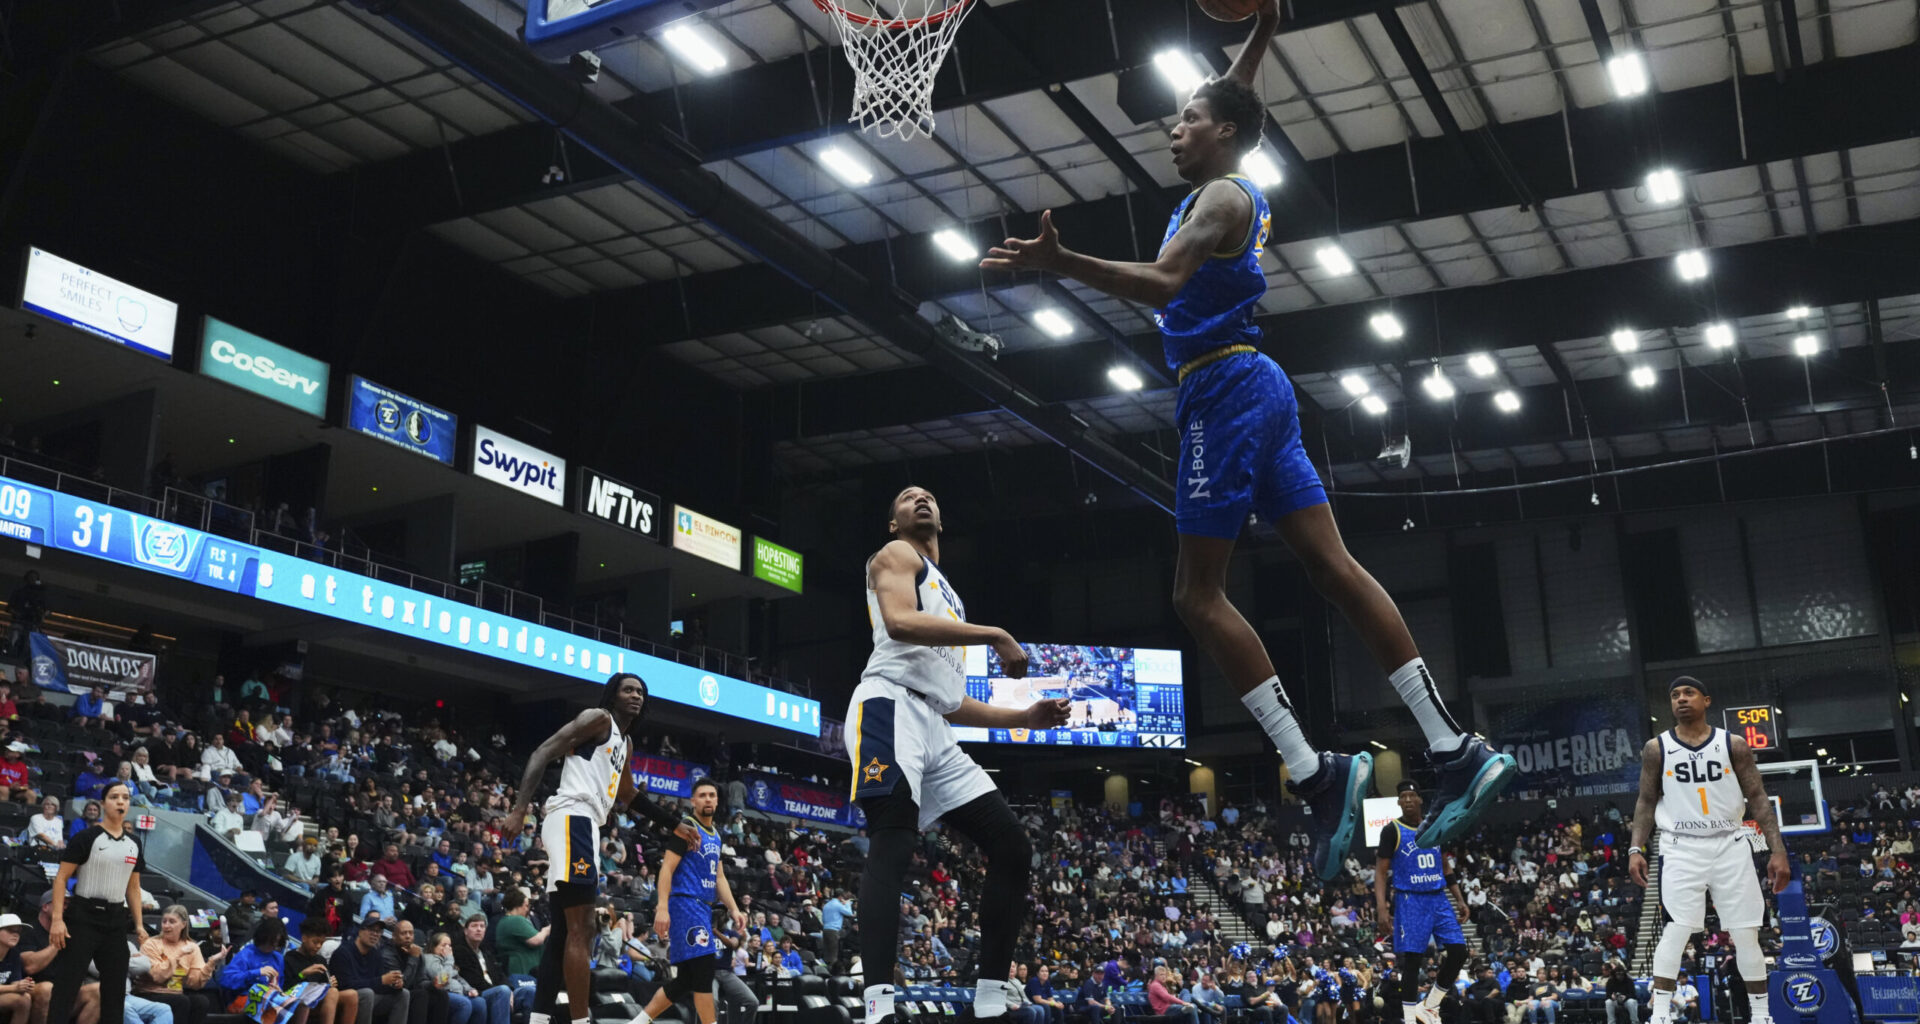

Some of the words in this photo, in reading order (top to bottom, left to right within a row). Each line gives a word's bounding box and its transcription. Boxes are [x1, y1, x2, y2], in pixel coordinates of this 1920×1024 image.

[61, 272, 112, 300] PERFECT
[60, 288, 102, 312] SMILES
[210, 340, 319, 395] CoServ
[478, 439, 557, 490] Swypit
[1188, 419, 1211, 499] N-BONE
[587, 475, 653, 534] NFTYS
[72, 505, 112, 553] 31
[694, 520, 703, 533] EL
[210, 546, 226, 562] FLS
[231, 552, 237, 566] 1
[757, 543, 800, 575] HOP&STING
[208, 563, 224, 580] TOL
[228, 569, 236, 583] 4
[301, 574, 337, 604] at
[66, 648, 142, 679] DONATOS
[1737, 708, 1769, 724] 5:09
[1034, 730, 1046, 743] 38
[1056, 731, 1072, 740] 5:09
[1082, 732, 1094, 744] 31
[1745, 726, 1768, 748] 16
[1573, 753, 1623, 776] CENTER
[1688, 752, 1705, 760] LVT
[632, 773, 649, 786] AM
[650, 776, 680, 791] ZONE
[1674, 760, 1722, 783] SLC
[784, 800, 811, 815] TEAM
[811, 805, 837, 820] ZONE
[1696, 787, 1709, 815] 1
[1674, 820, 1708, 830] ZIONS
[1710, 819, 1735, 829] BANK
[1417, 853, 1435, 869] 00
